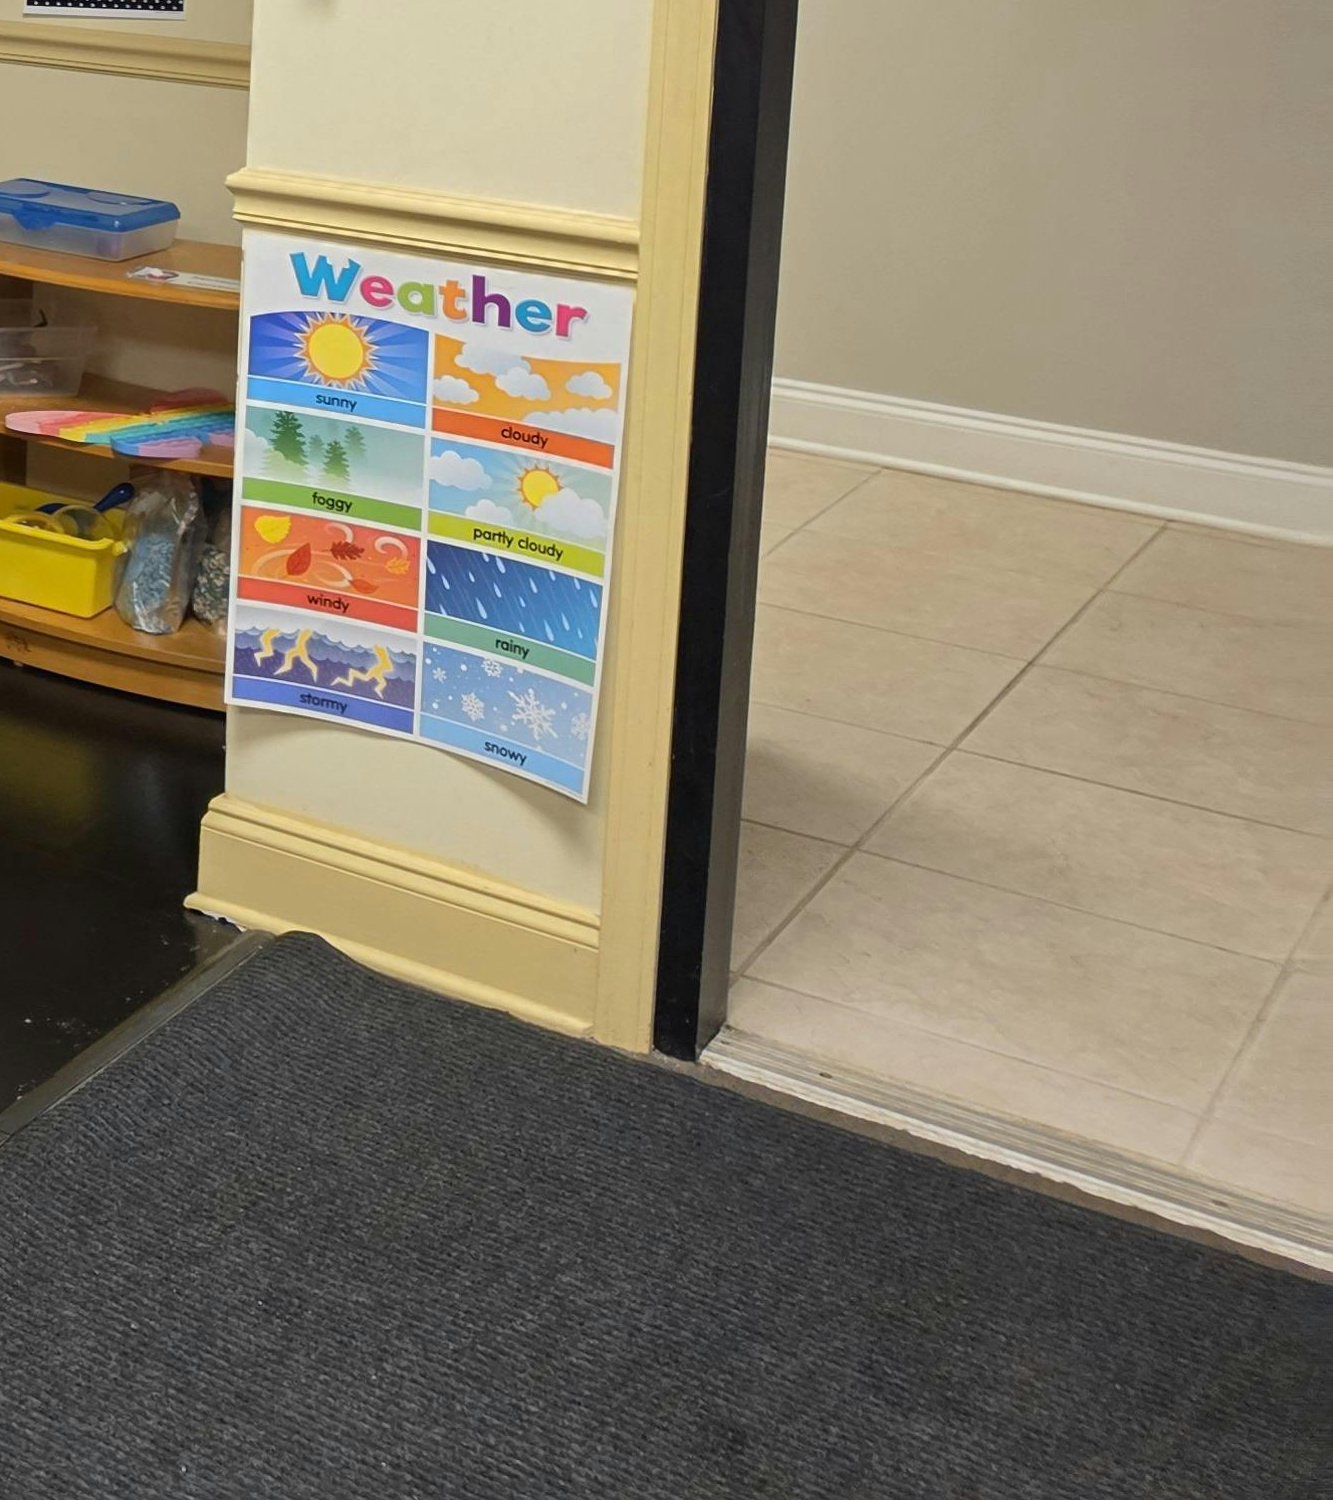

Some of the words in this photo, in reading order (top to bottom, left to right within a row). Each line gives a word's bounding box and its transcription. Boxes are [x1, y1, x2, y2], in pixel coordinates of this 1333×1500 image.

[289, 252, 590, 340] Weather
[315, 394, 358, 413] sunny
[500, 426, 549, 449] cloudy
[312, 492, 353, 513] foggy
[473, 526, 514, 548] partly
[517, 536, 564, 561] cloudy
[307, 592, 350, 613] windy
[494, 637, 530, 659] rainy
[299, 691, 348, 713] stormy
[484, 739, 528, 766] snowy
